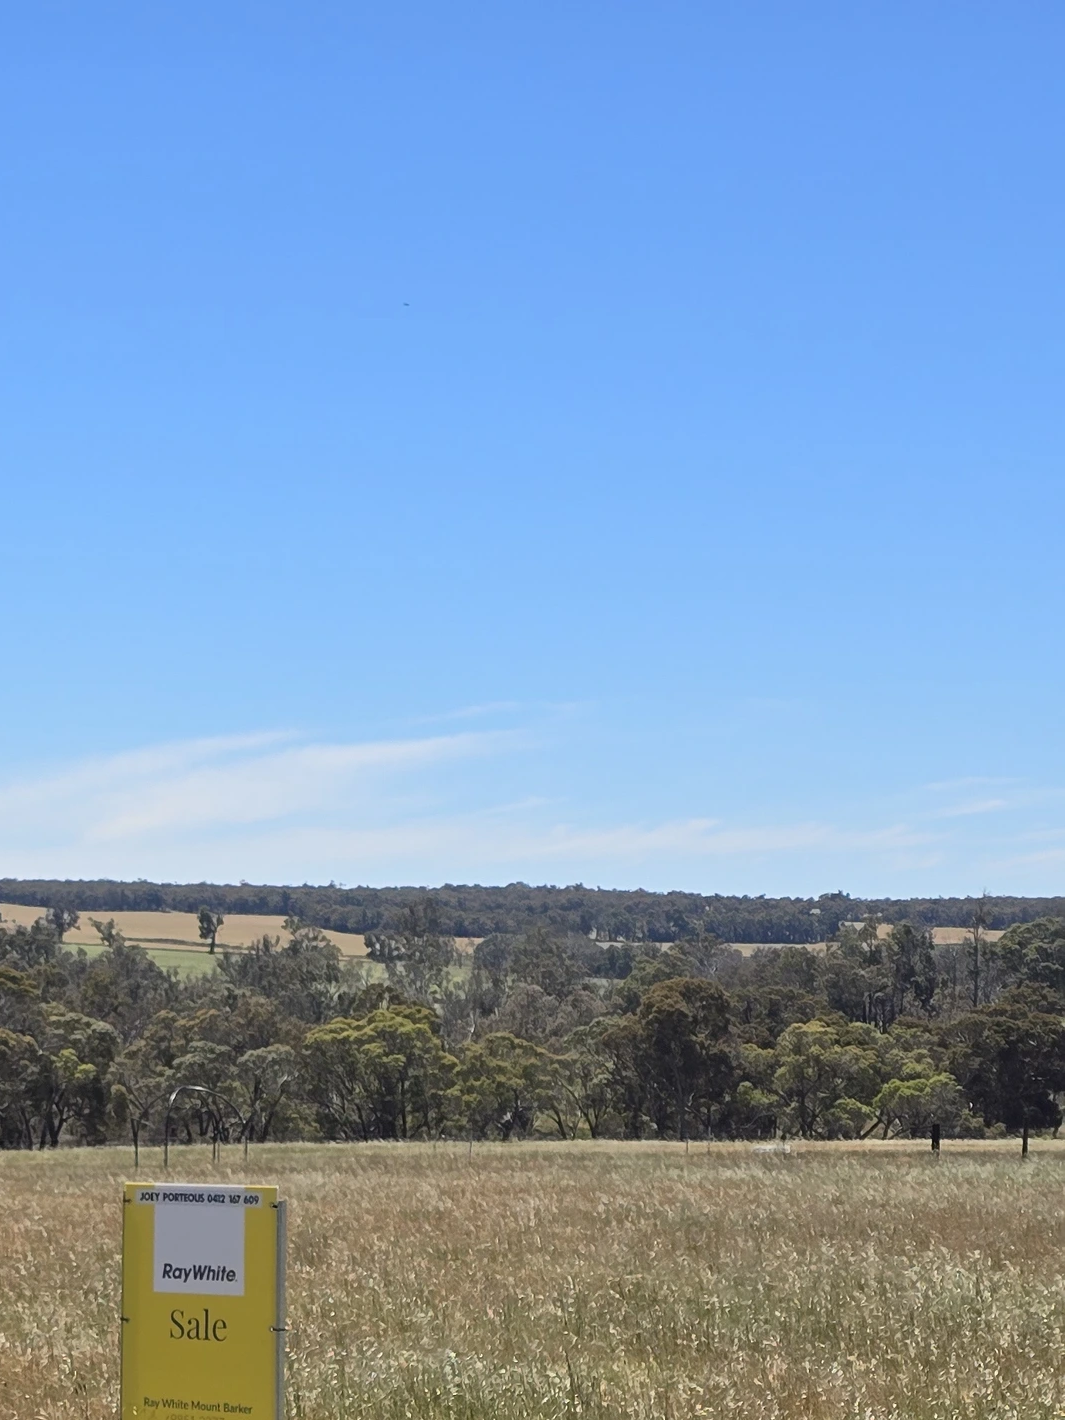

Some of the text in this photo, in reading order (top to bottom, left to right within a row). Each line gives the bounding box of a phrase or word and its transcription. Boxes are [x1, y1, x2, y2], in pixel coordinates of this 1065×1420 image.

[162, 1192, 205, 1204] PORTEOUS
[243, 1195, 260, 1205] 609
[170, 1308, 227, 1341] Sale
[143, 1397, 253, 1415] Ray White Mount Barker
